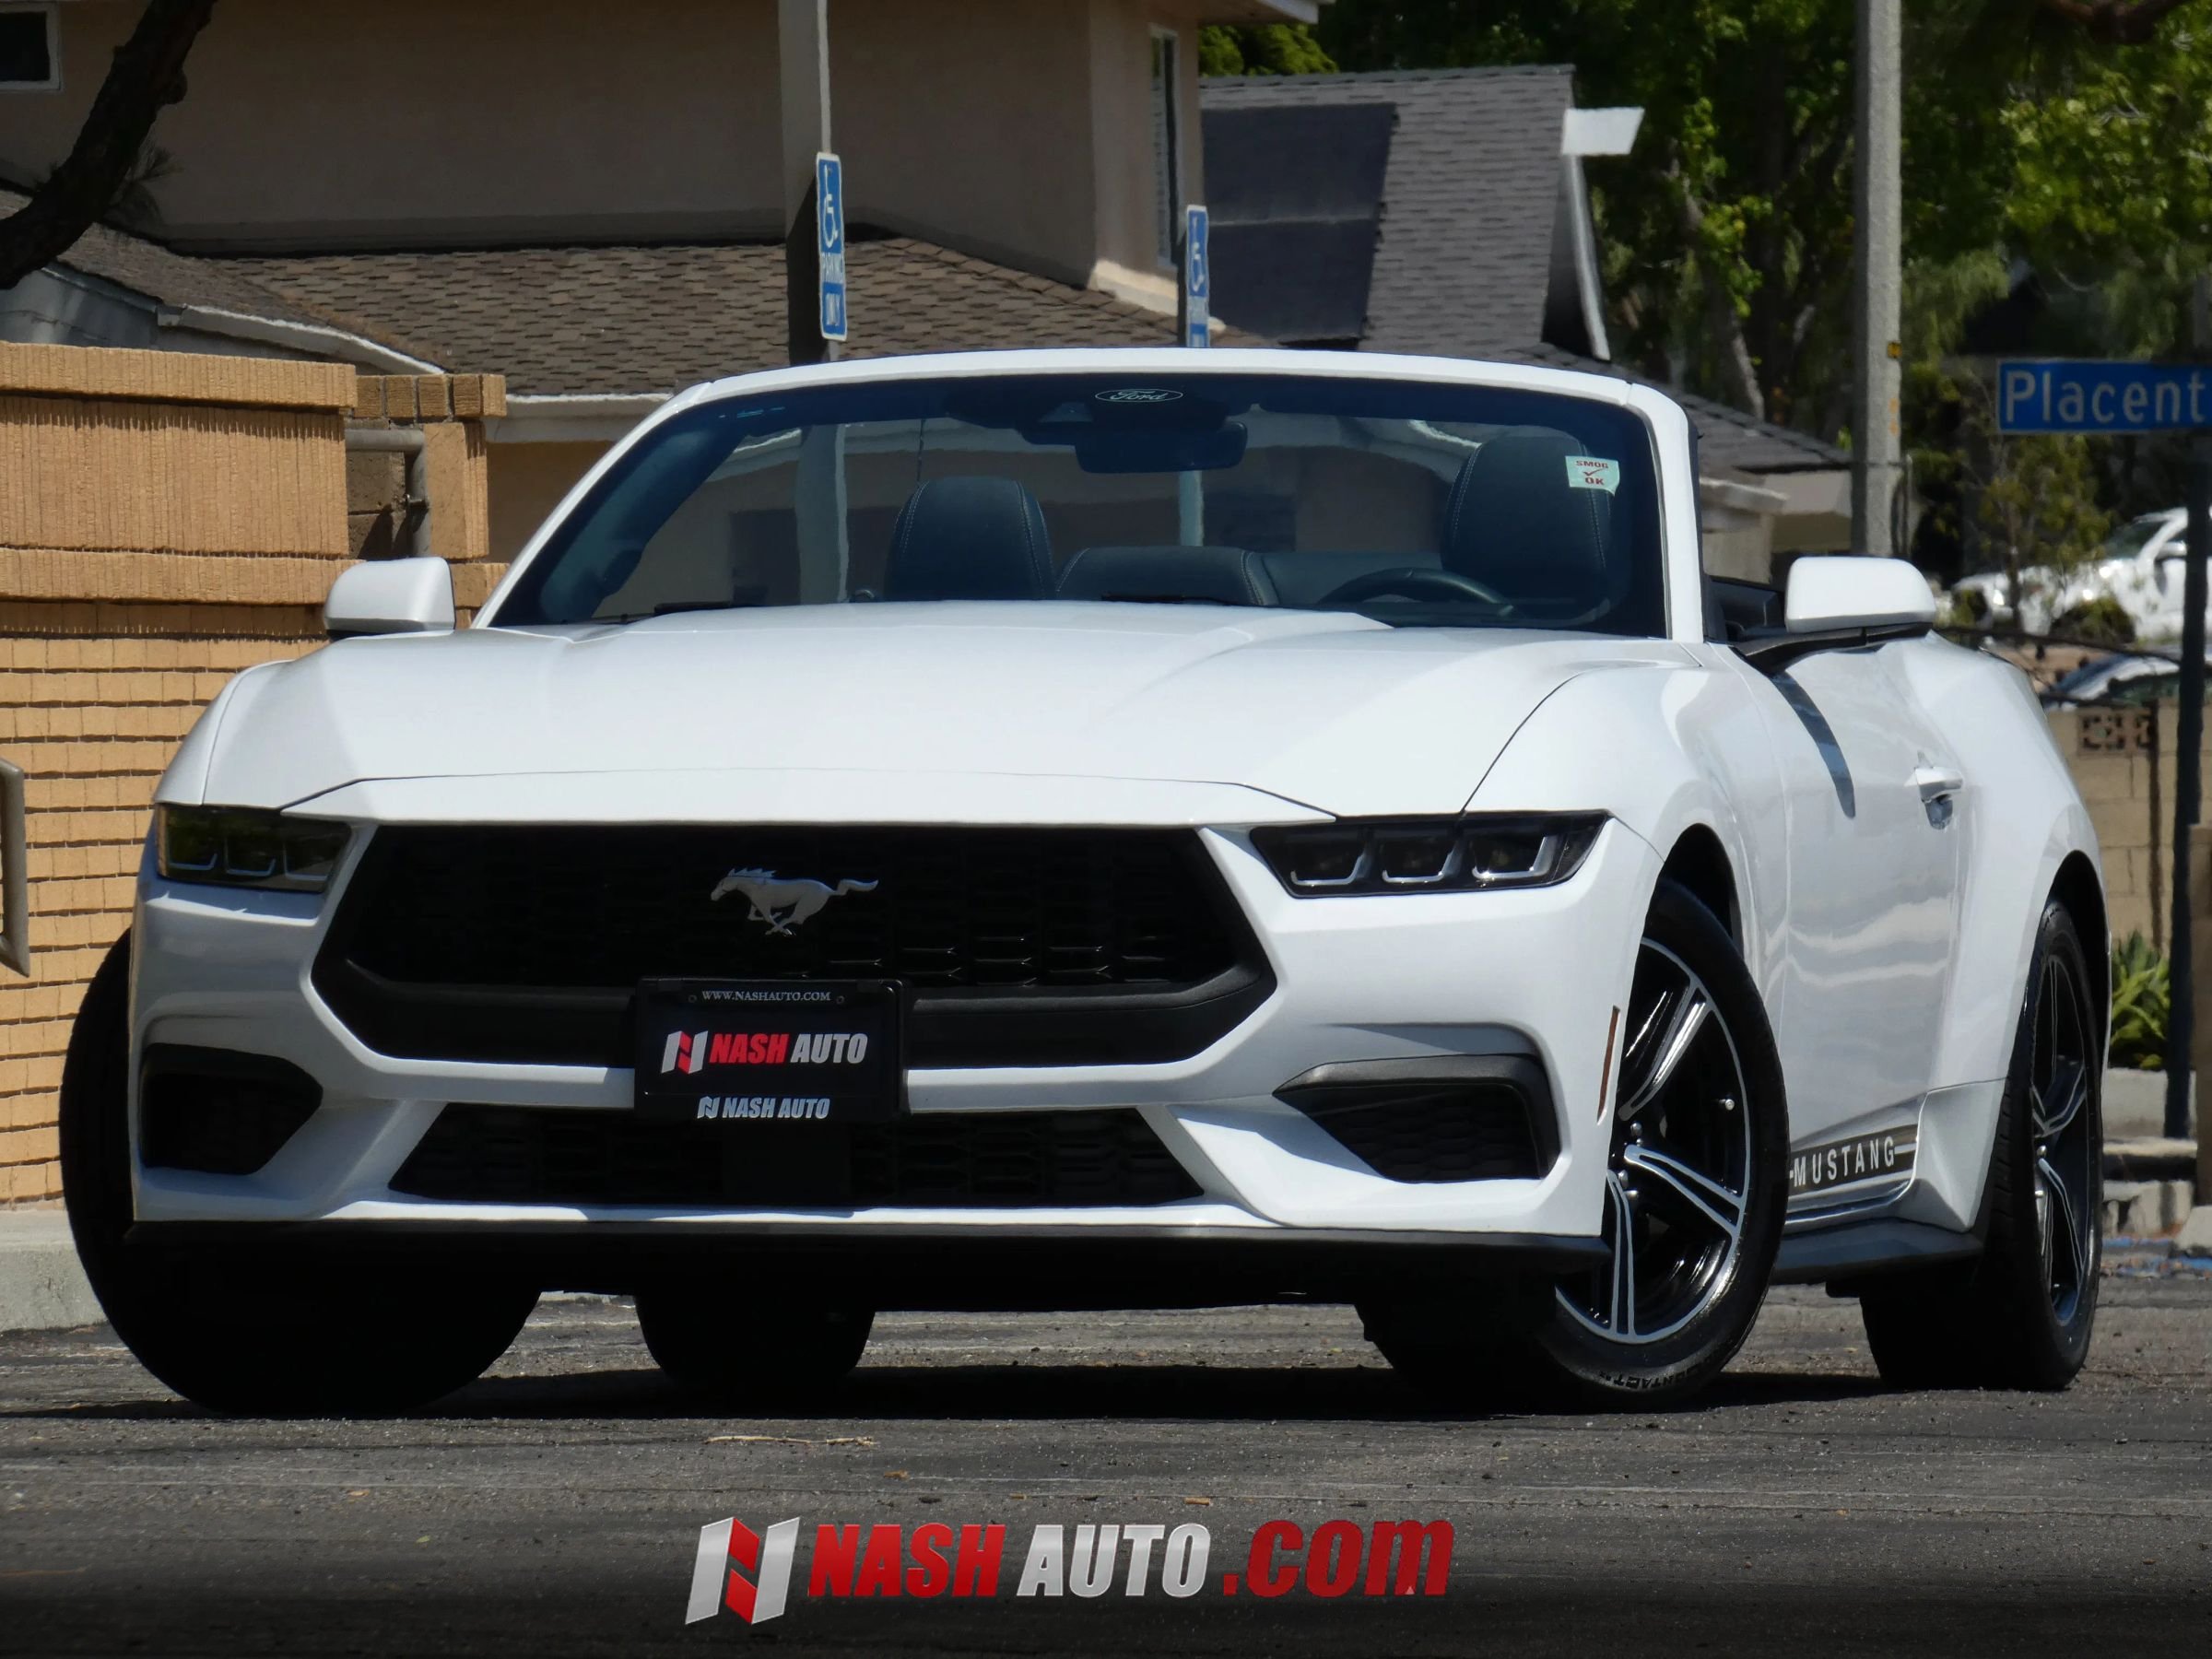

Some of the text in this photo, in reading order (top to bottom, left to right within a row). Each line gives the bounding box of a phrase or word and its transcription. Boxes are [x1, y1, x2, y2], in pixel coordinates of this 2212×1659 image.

[1109, 390, 1169, 400] Ford
[1585, 477, 1605, 486] OK
[701, 990, 830, 1003] WWW.NASHAUTO.COM
[709, 1033, 790, 1064] NASH
[790, 1033, 868, 1064] AUTO
[722, 1097, 776, 1119] NASH
[777, 1098, 830, 1119] AUTO
[1793, 1135, 1895, 1187] MUSTANG
